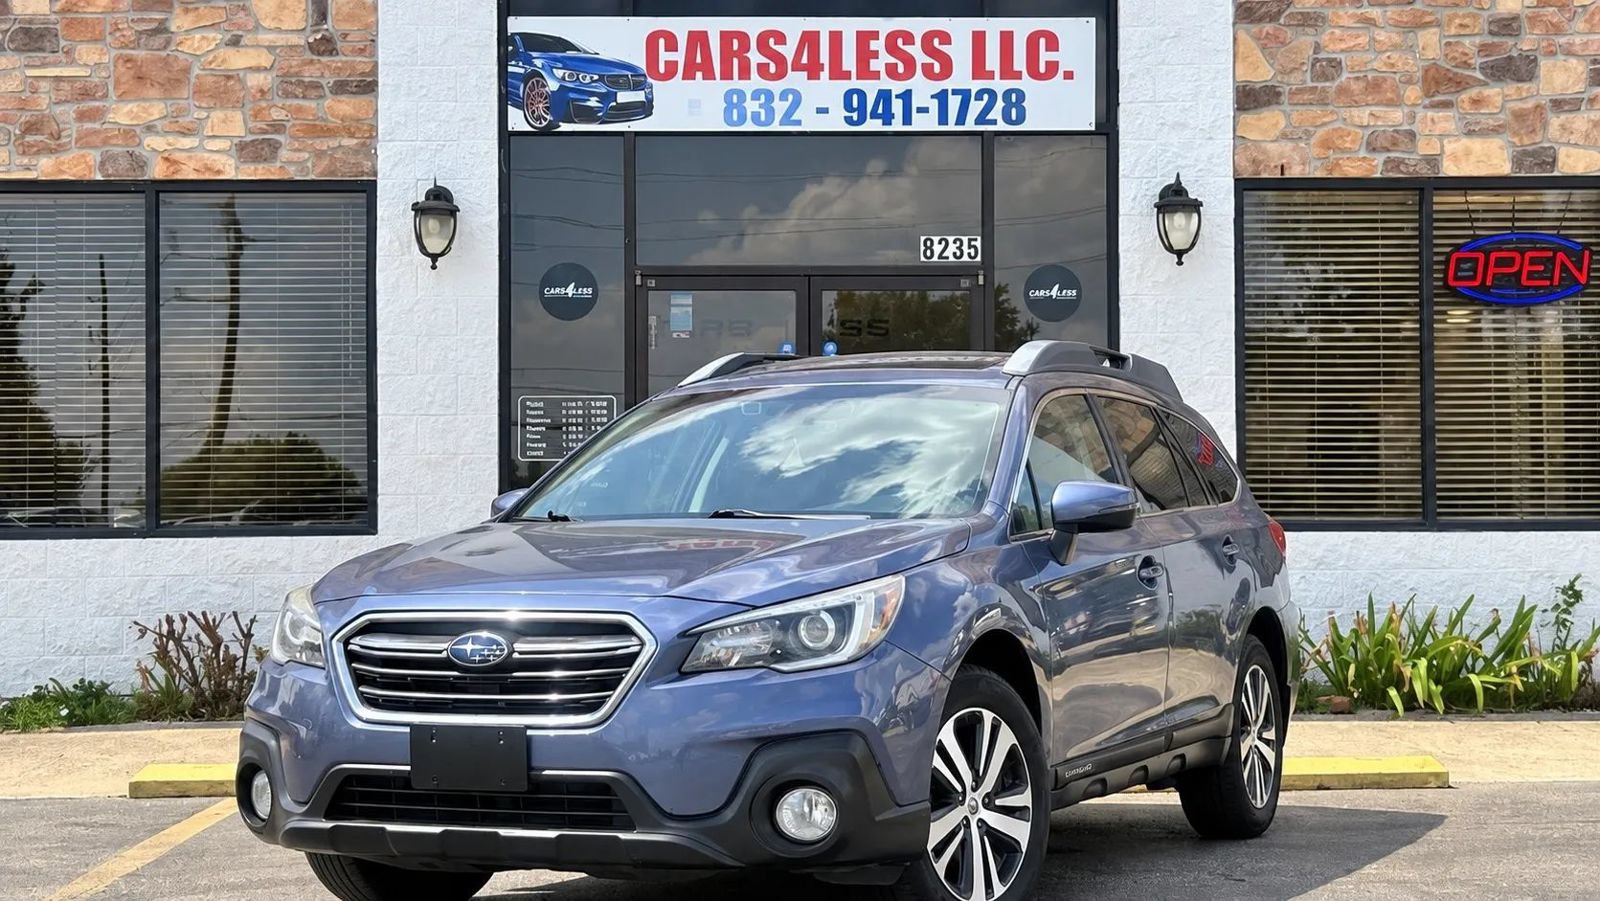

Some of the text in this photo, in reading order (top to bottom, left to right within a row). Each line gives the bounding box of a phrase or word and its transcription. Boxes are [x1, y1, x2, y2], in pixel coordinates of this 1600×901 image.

[645, 29, 1075, 82] CARS4LESS LLC.
[722, 87, 803, 127] 832
[843, 87, 1027, 127] 941-1728
[922, 237, 980, 261] 8235
[1447, 250, 1591, 287] OPEN
